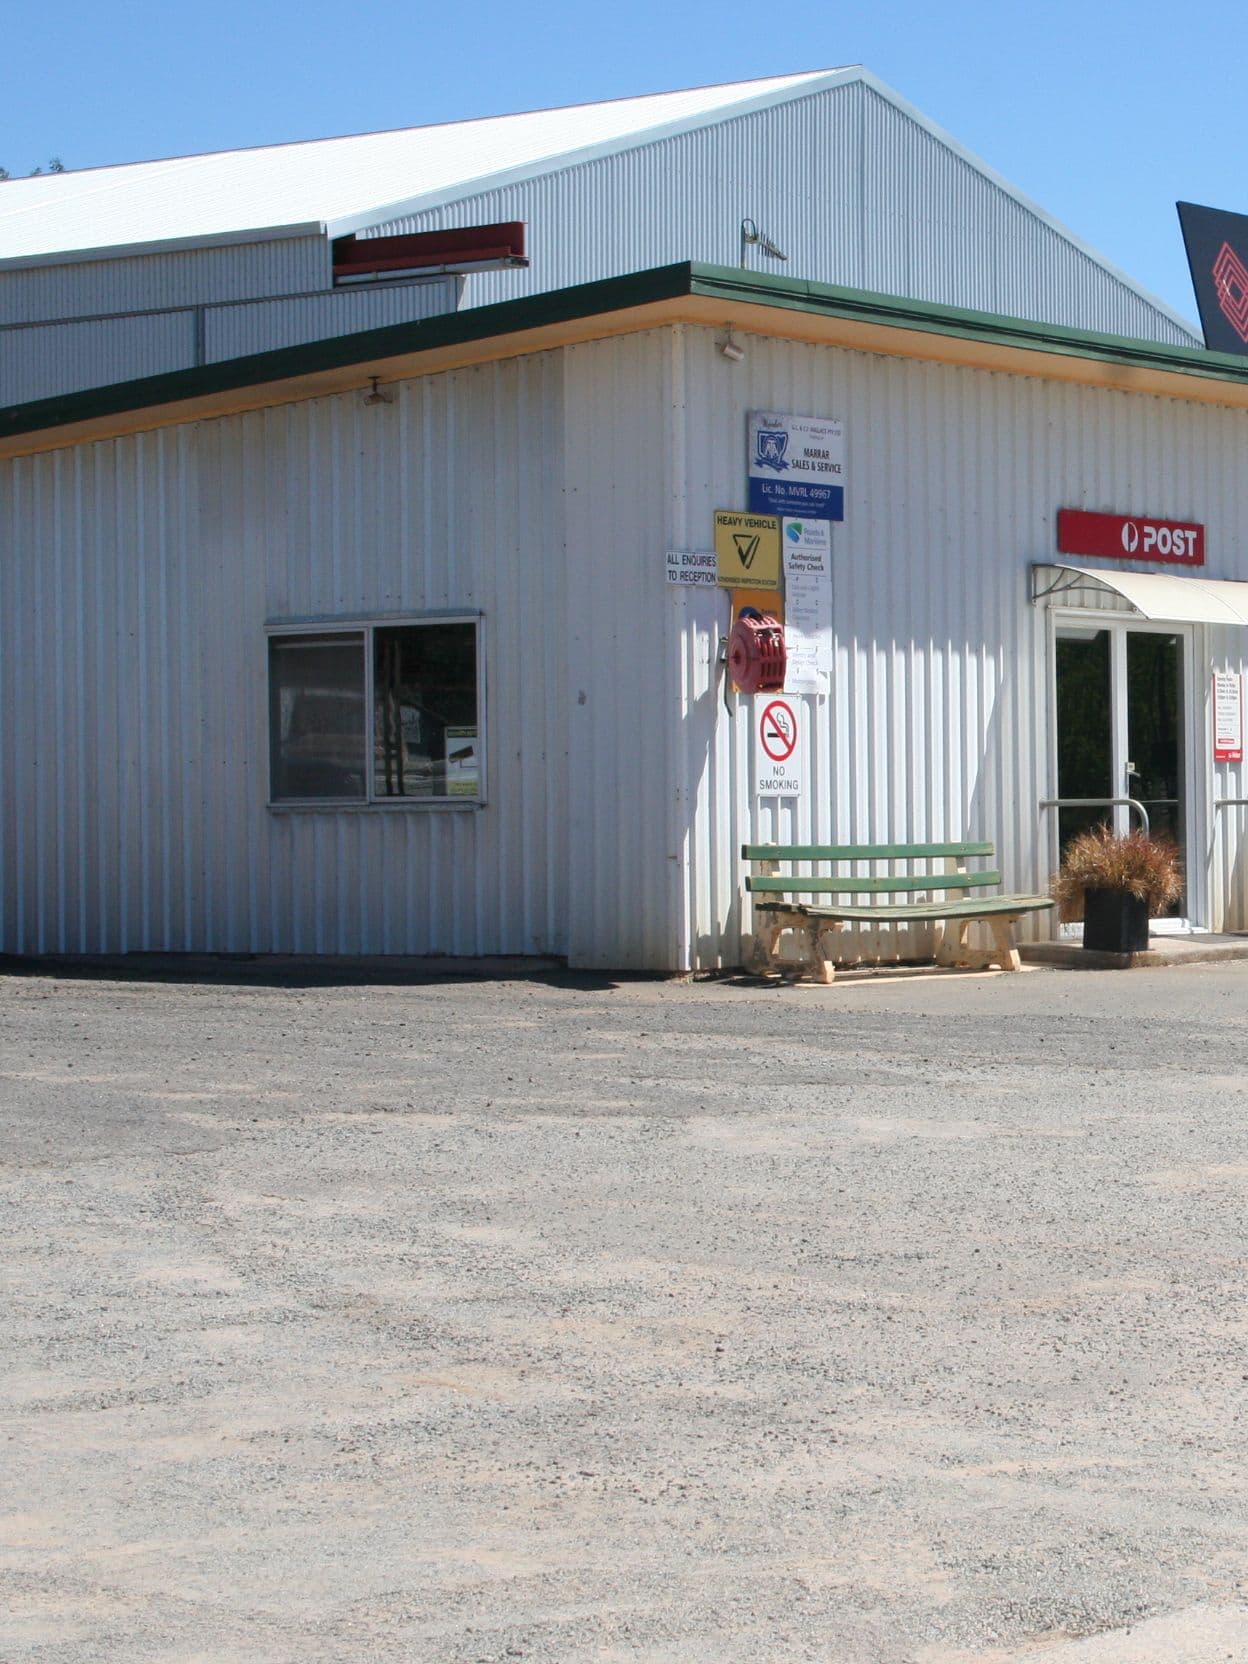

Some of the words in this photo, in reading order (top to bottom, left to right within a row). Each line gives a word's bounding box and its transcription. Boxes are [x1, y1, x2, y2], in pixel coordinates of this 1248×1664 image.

[804, 447, 830, 459] MARRAR
[791, 459, 810, 471] SALES
[811, 462, 816, 471] &
[817, 462, 842, 474] SERVICE
[717, 516, 742, 527] HEAVY
[744, 518, 777, 530] VEHICLE
[1143, 525, 1197, 557] POST
[667, 554, 680, 566] ALL
[682, 555, 717, 568] ENQUIRIES
[790, 553, 821, 562] Authorised
[788, 562, 806, 571] Safety
[807, 563, 824, 571] Check
[668, 570, 677, 581] TO
[680, 571, 716, 583] RECEPTION
[773, 766, 785, 776] NO
[759, 780, 799, 790] SMOKING
